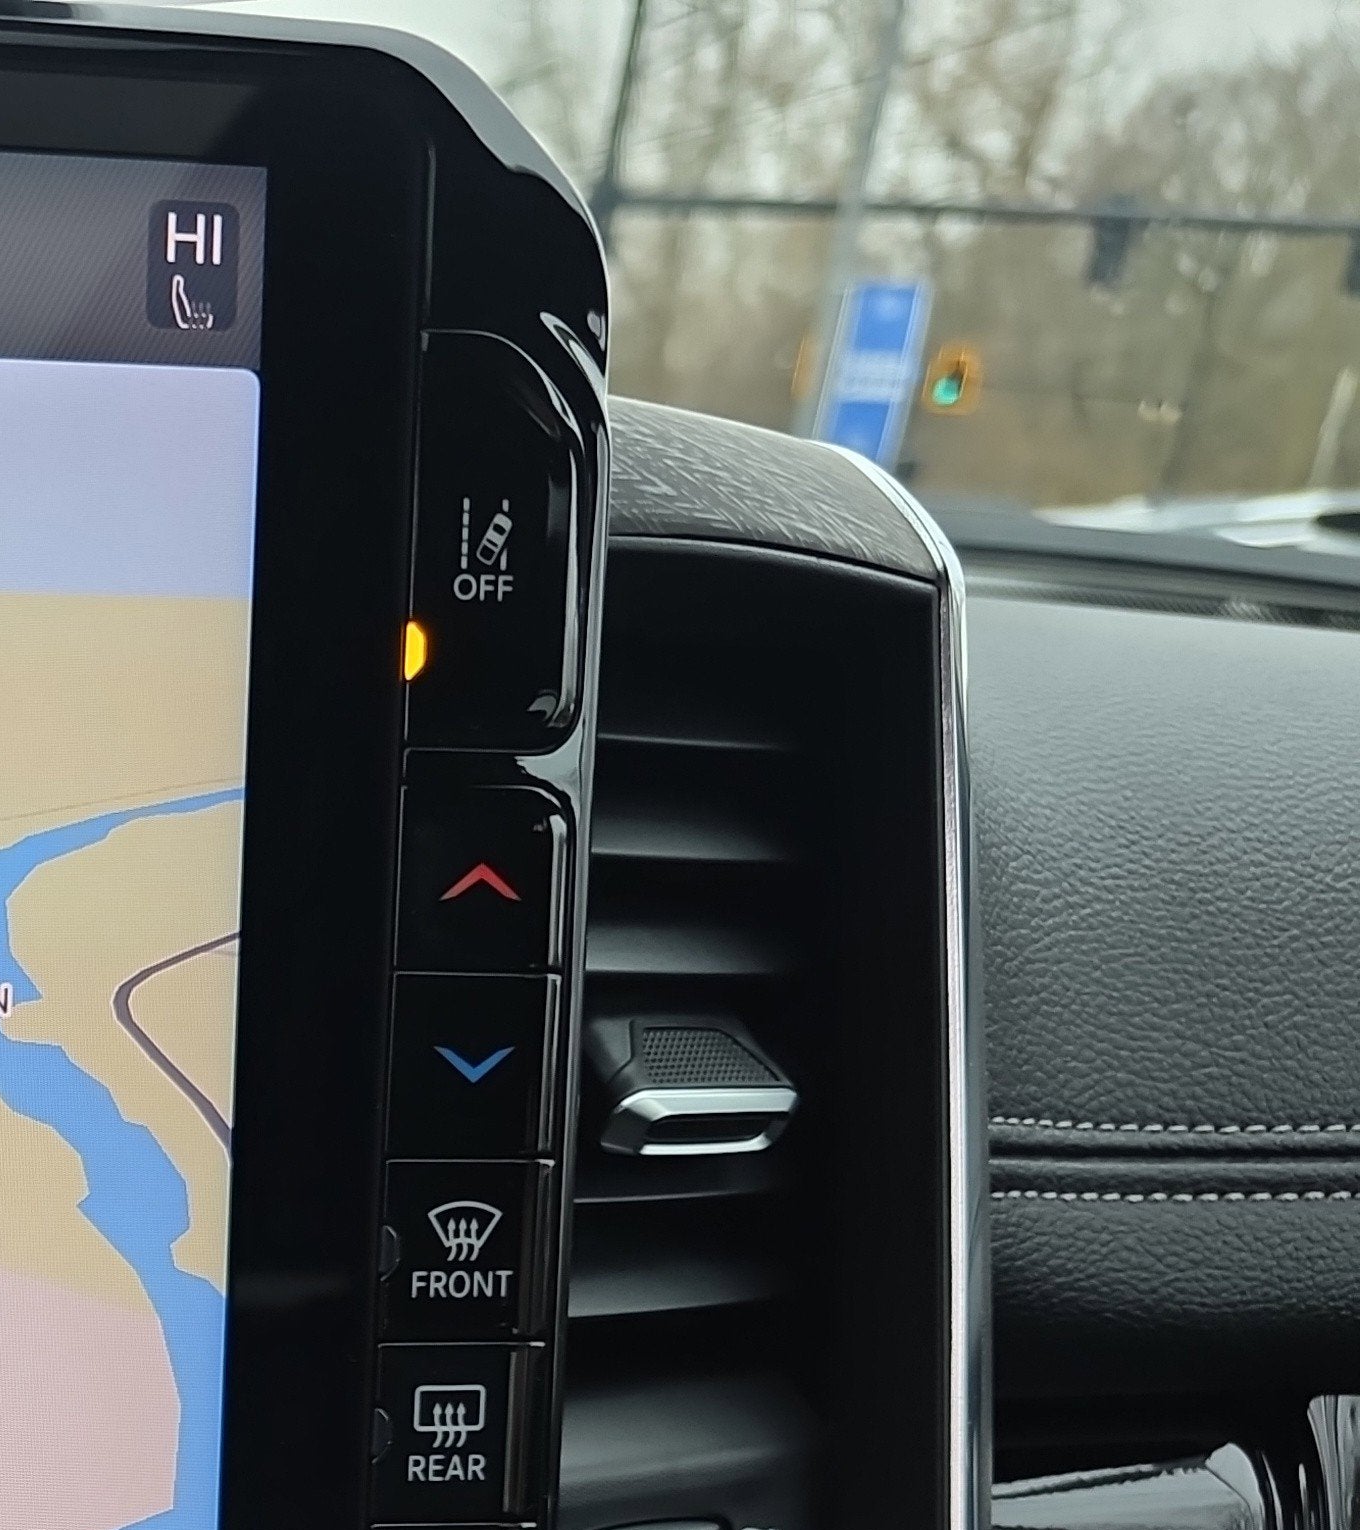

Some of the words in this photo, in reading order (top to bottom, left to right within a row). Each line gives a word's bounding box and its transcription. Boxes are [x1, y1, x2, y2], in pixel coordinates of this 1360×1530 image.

[166, 211, 223, 265] HI
[453, 573, 514, 602] OFF
[411, 1270, 514, 1299] FRONT
[407, 1454, 486, 1482] REAR
